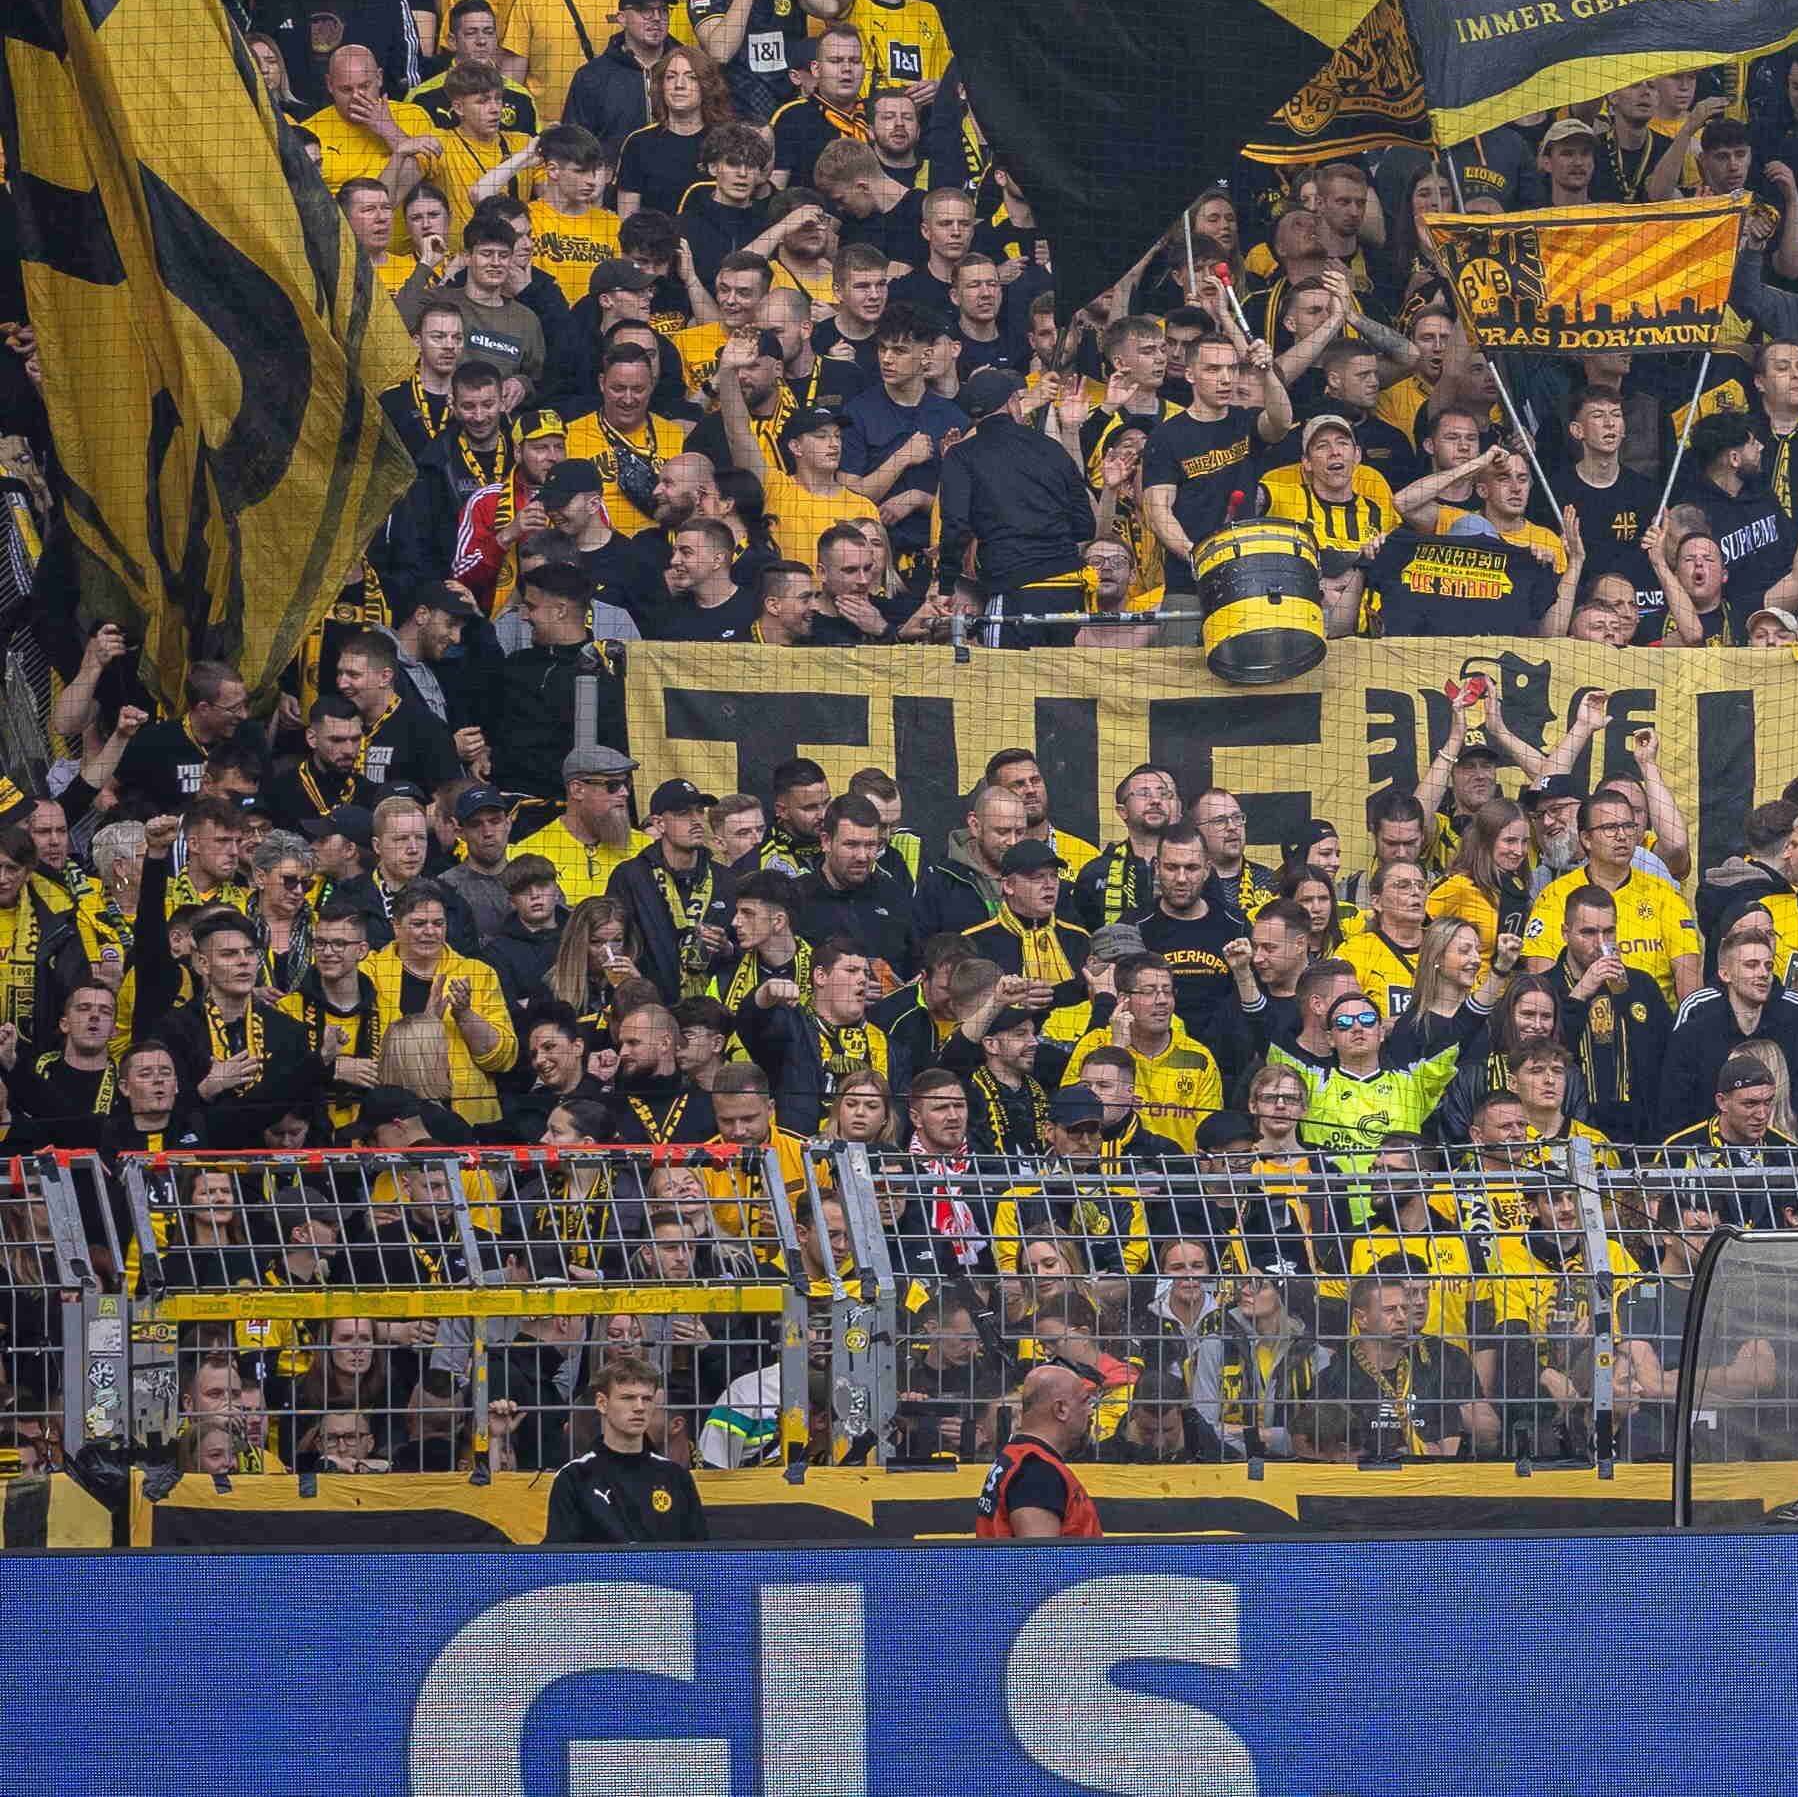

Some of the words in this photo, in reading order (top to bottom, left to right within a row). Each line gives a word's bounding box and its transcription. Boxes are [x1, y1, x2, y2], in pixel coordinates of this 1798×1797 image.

[1456, 3, 1564, 45] IMMER
[751, 41, 781, 62] 1&1
[890, 48, 920, 73] 1&1
[470, 335, 519, 355] ellesse
[663, 686, 1323, 858] THE
